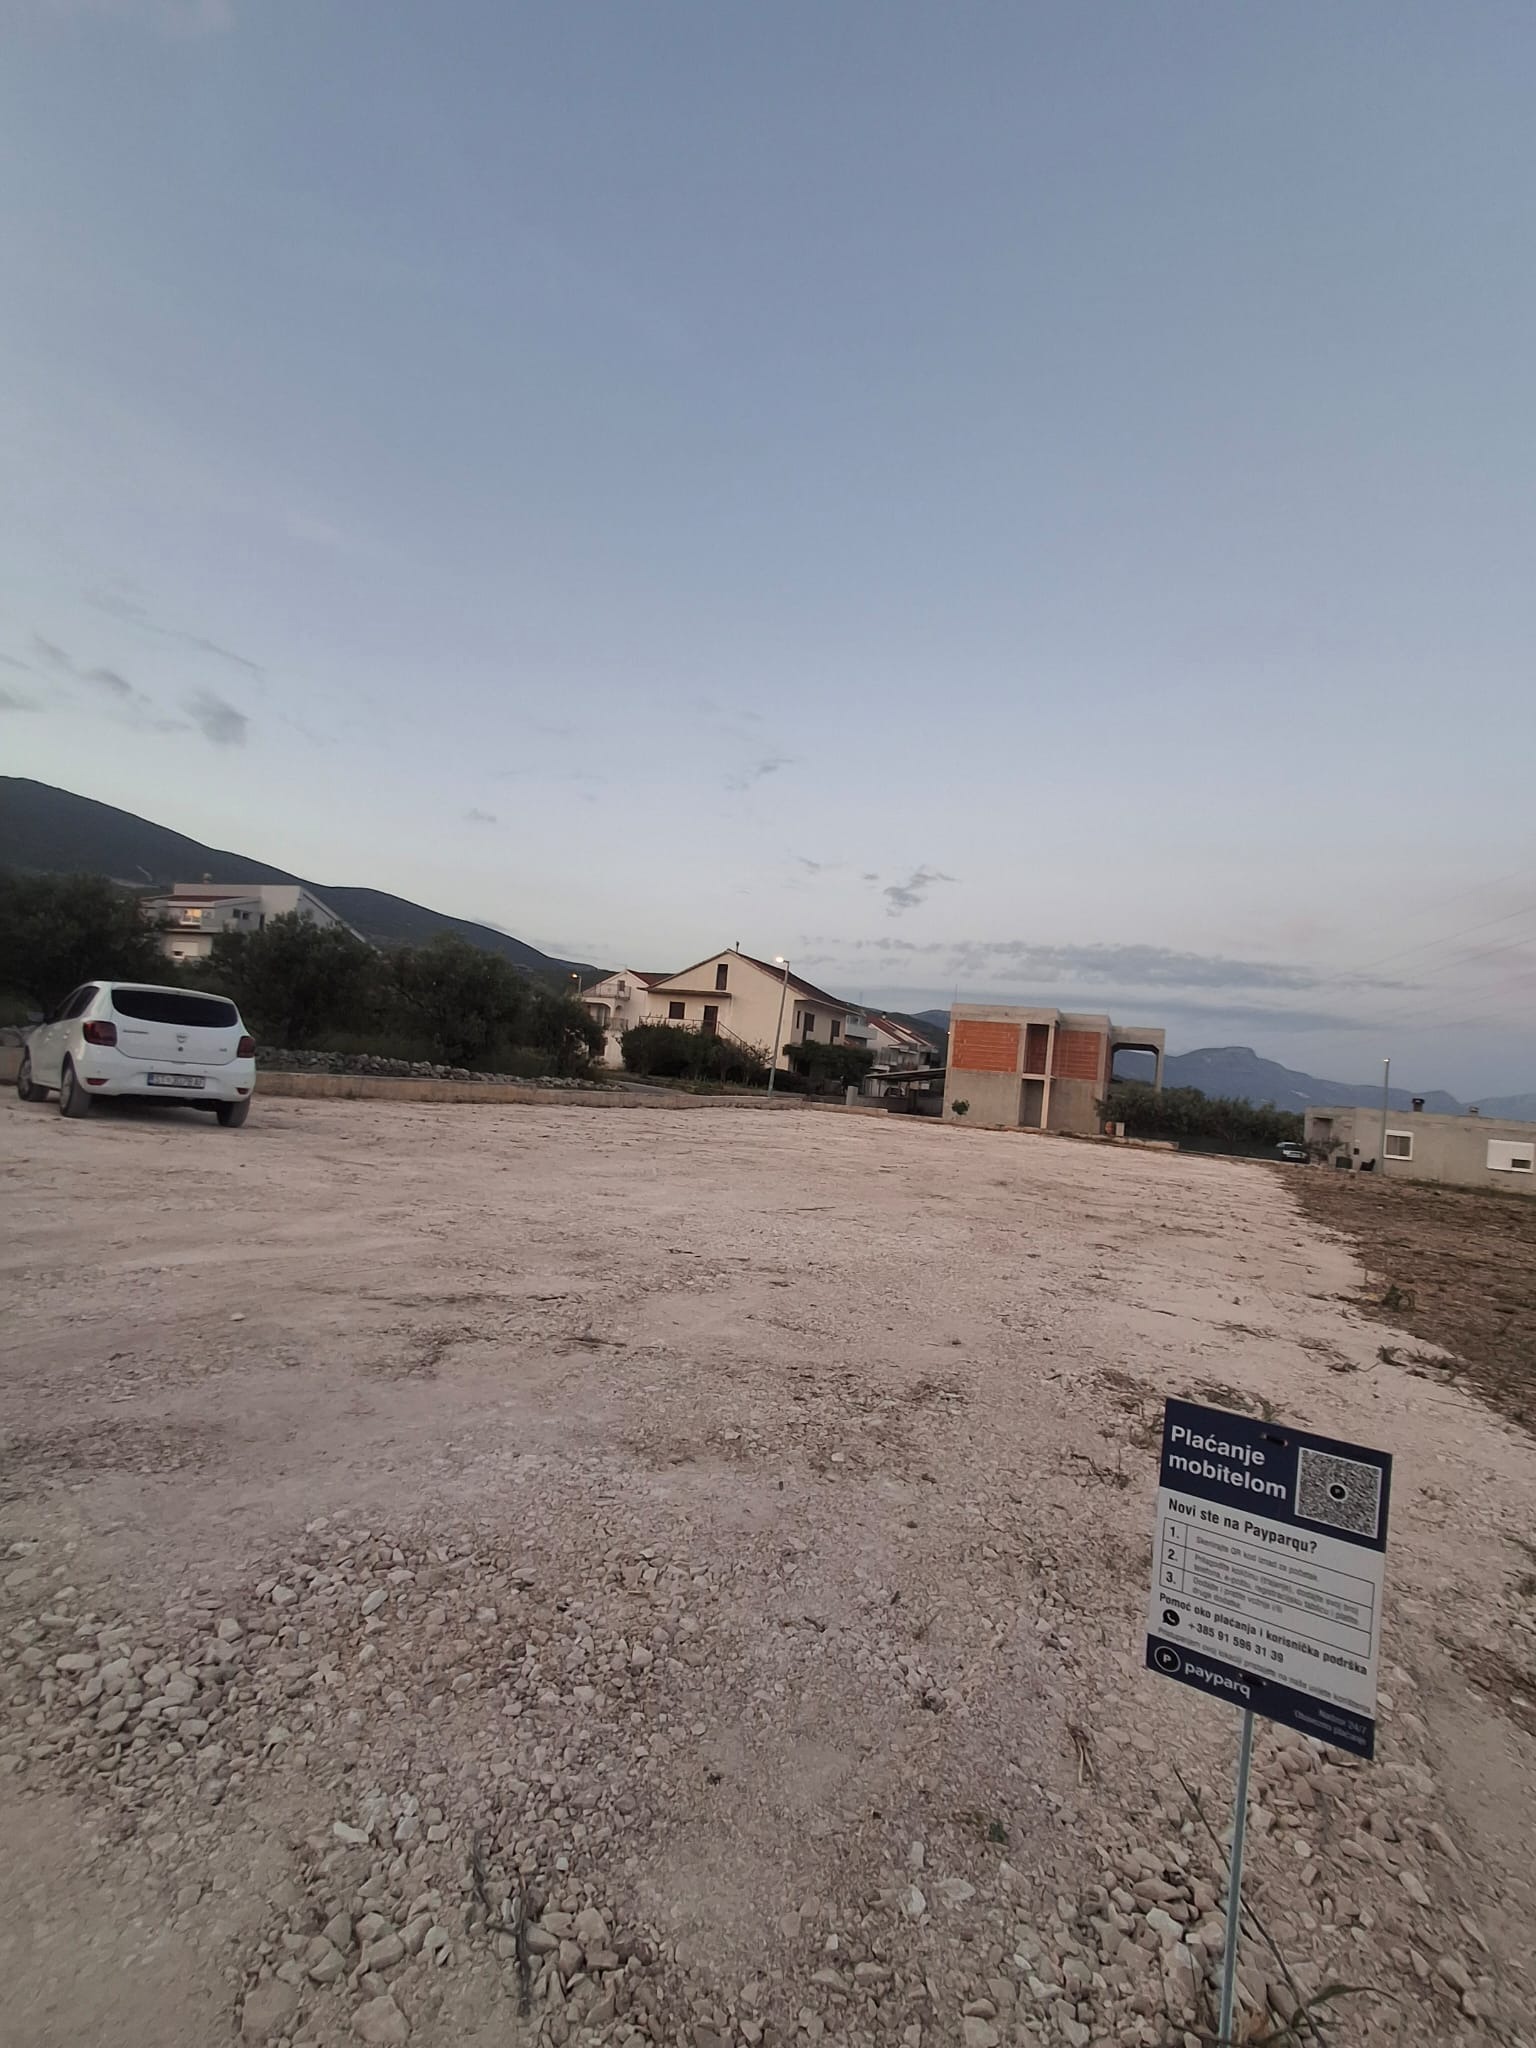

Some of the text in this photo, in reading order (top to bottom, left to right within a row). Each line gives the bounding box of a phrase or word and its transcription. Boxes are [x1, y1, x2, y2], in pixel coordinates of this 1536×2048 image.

[1171, 1425, 1265, 1466] Plaćanje
[1169, 1454, 1286, 1499] mobitelom
[1168, 1498, 1196, 1517] Novi
[1200, 1508, 1219, 1524] ste
[1223, 1515, 1240, 1530] na
[1244, 1520, 1318, 1554] Payparqu?
[1170, 1526, 1180, 1539] 1.
[1167, 1548, 1178, 1561] 2.
[1165, 1571, 1176, 1584] 3.
[1160, 1592, 1191, 1611] Pomoć
[1194, 1606, 1211, 1618] oko
[1214, 1613, 1257, 1635] plaćanja
[1266, 1630, 1320, 1658] korisnička
[1322, 1652, 1368, 1675] podrška
[1188, 1622, 1215, 1637] +385
[1218, 1630, 1229, 1642] 91
[1254, 1644, 1267, 1656] 31
[1270, 1650, 1284, 1663] 39
[1162, 1653, 1172, 1663] P
[1185, 1662, 1251, 1699] payparq
